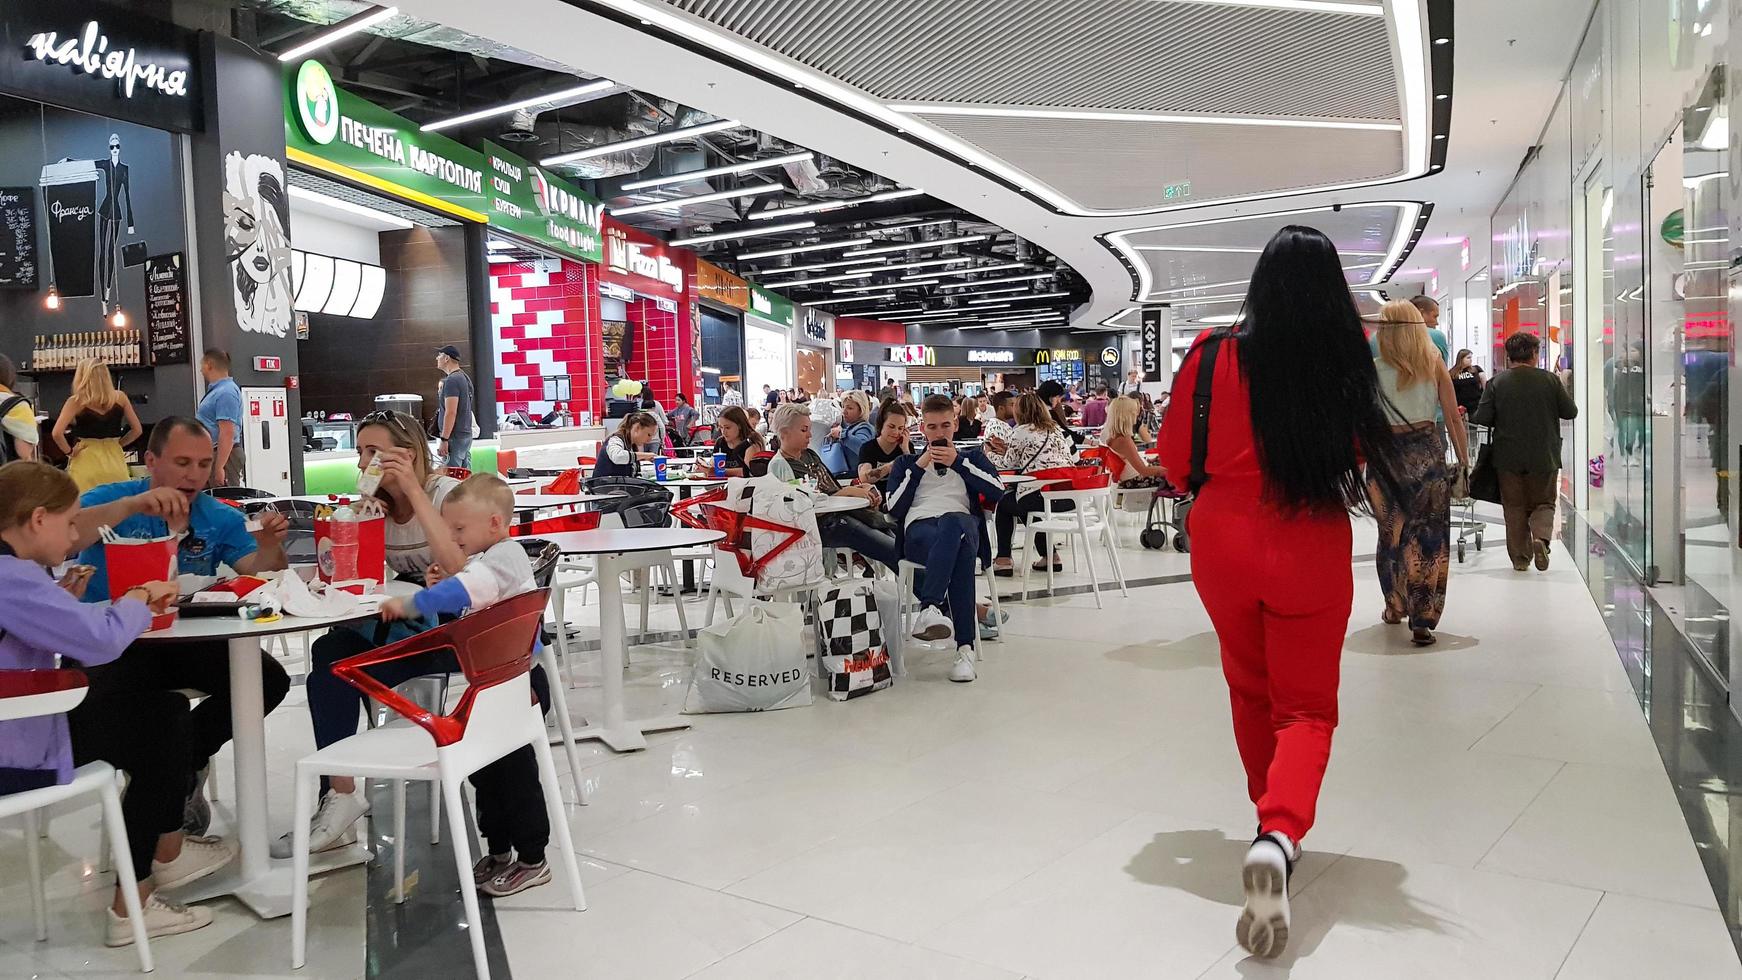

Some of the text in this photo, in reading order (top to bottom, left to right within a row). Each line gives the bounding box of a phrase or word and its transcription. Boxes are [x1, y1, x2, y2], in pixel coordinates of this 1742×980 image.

[340, 115, 483, 194] ПЕЧЕНА КАРТОПЛЯ
[711, 667, 801, 687] RESERVED
